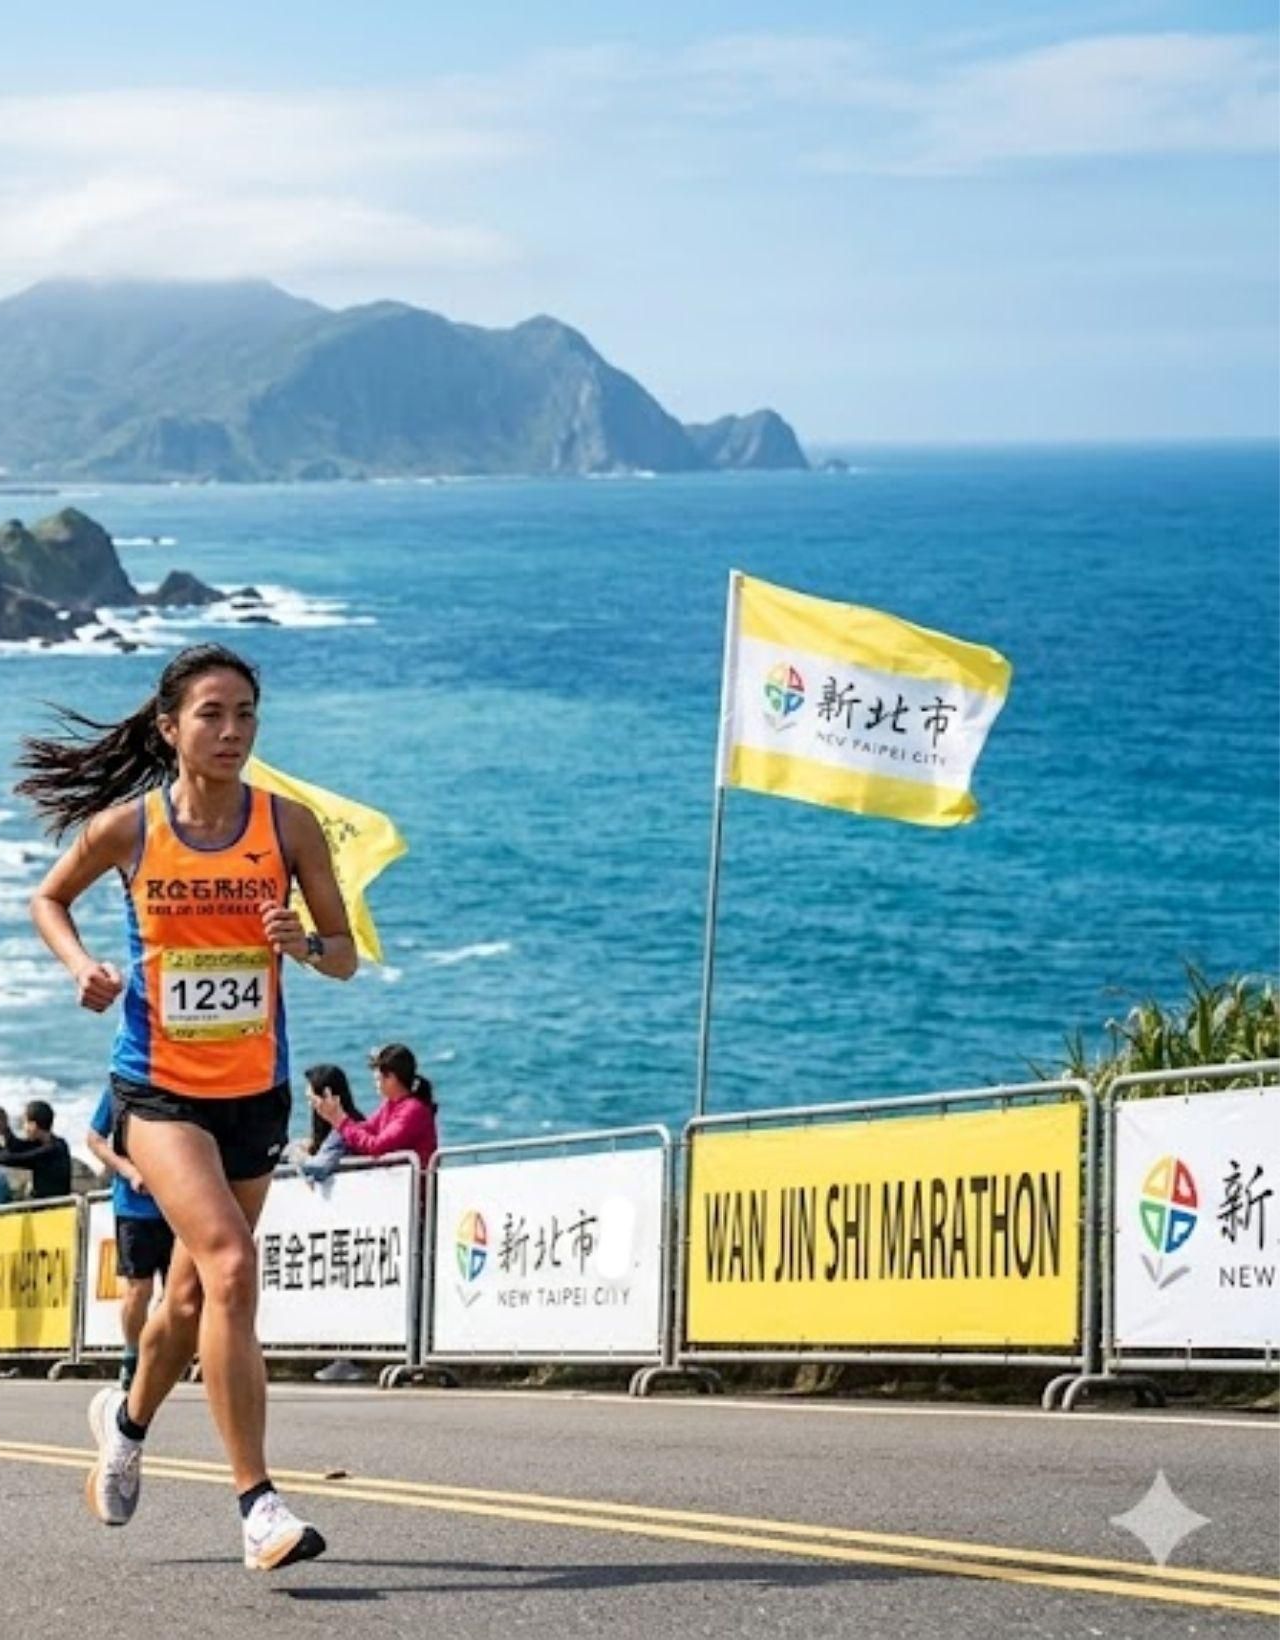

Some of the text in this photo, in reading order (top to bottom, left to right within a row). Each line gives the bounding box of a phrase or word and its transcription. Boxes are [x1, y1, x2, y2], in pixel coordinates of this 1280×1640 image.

[818, 675, 957, 749] 新北市
[170, 976, 263, 1011] 1234
[704, 1170, 1061, 1283] WAN JIN SHI MARATHON
[1216, 1158, 1275, 1252] 新
[497, 1208, 598, 1278] 新北市
[1219, 1265, 1277, 1289] NEW
[497, 1288, 532, 1308] NEW
[538, 1286, 588, 1307] TAIPEI
